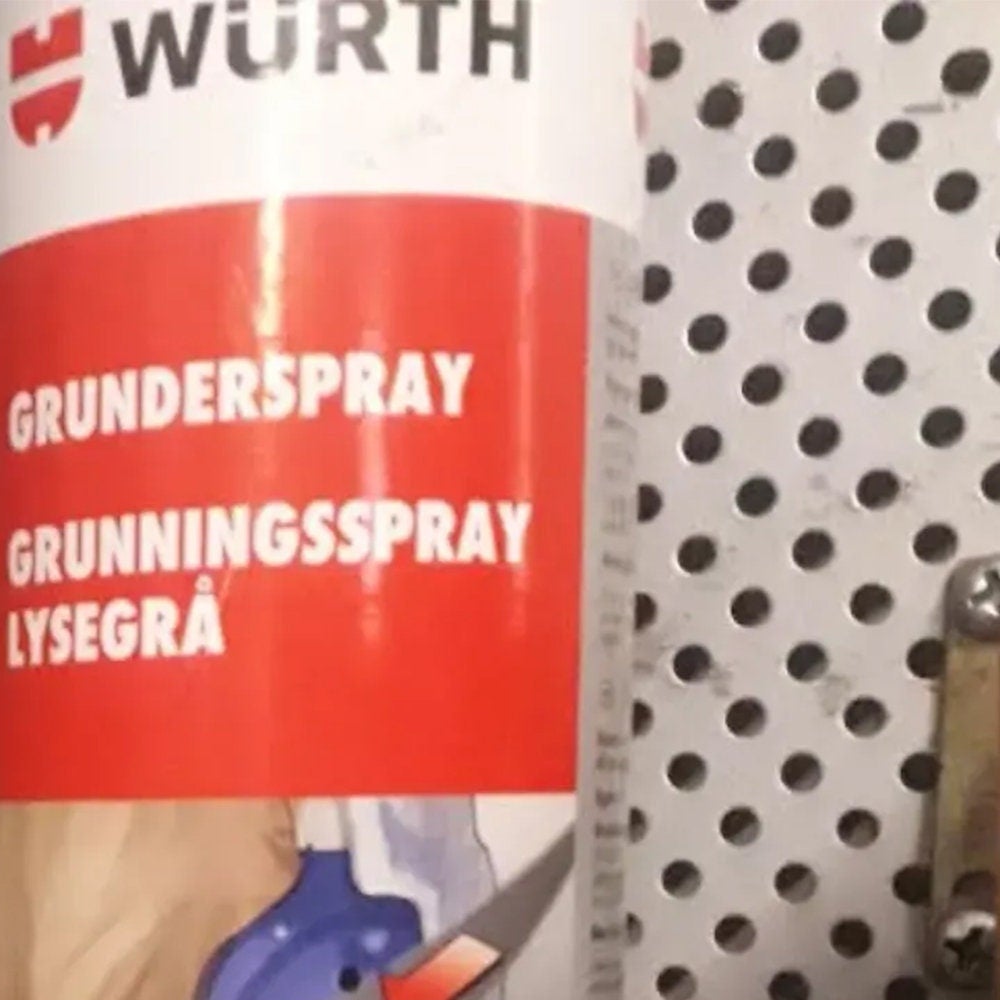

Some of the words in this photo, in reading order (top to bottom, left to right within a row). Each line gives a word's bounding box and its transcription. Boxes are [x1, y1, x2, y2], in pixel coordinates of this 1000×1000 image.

[111, 0, 531, 98] WÜRTH
[7, 351, 474, 453] GRUNDERSPRAY
[7, 500, 533, 587] GRUNNINGSSPRAY
[6, 575, 225, 668] LYSEGRÅ
